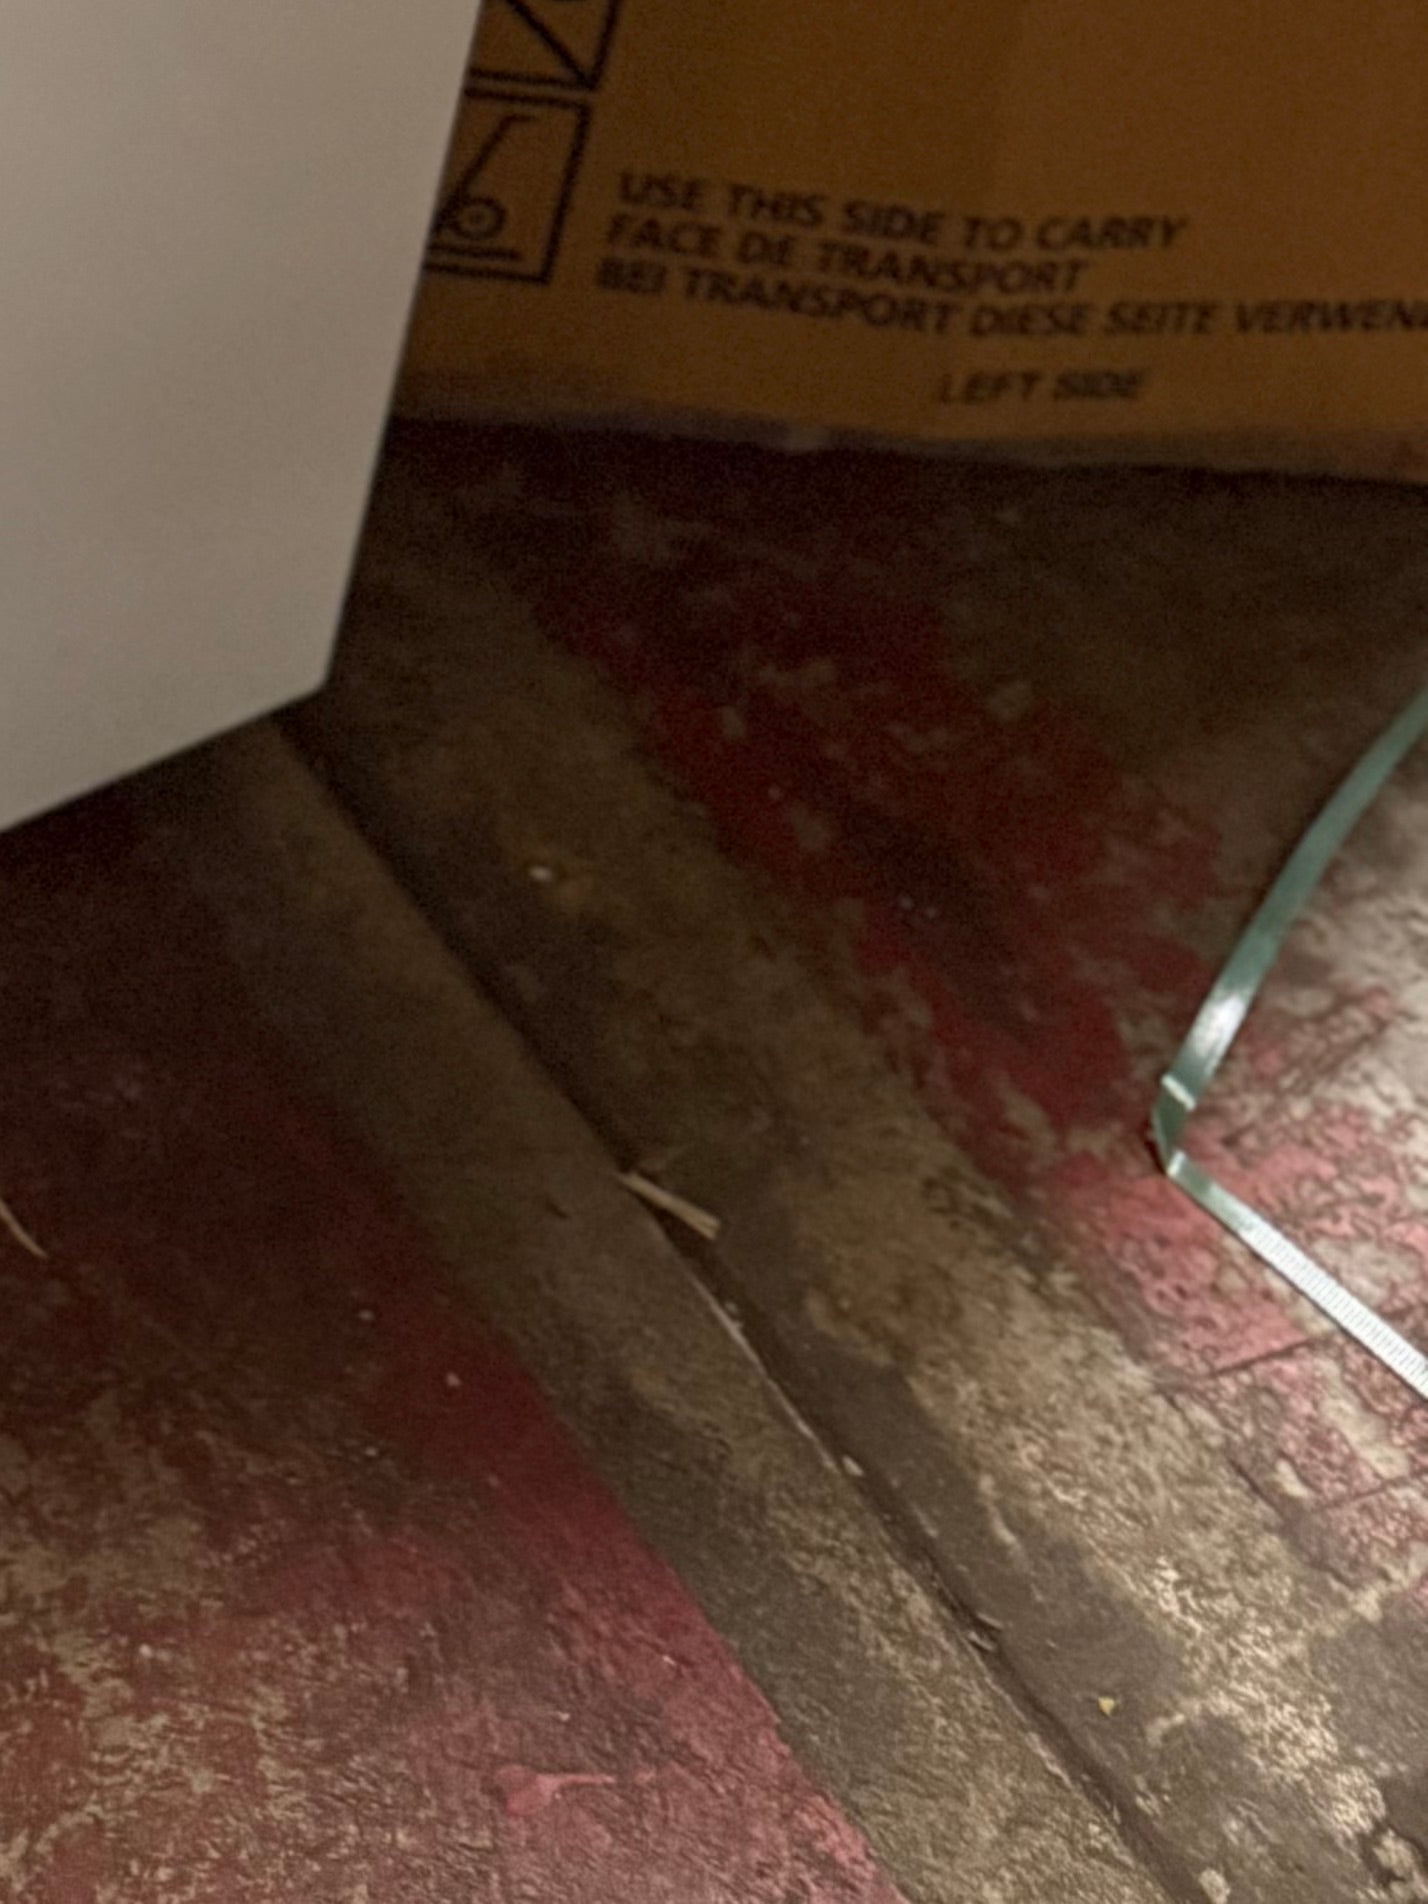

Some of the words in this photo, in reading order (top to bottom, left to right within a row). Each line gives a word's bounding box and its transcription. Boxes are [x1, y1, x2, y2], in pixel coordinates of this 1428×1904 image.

[617, 171, 702, 209] USE
[727, 182, 828, 228] THIS
[841, 200, 947, 247] SIDE
[963, 214, 1024, 252] TO
[1035, 213, 1190, 252] CARRY
[604, 212, 722, 258] FACE
[736, 230, 798, 267] DE
[815, 240, 1089, 296] TRANSPORT
[597, 257, 667, 294] BEI
[682, 265, 958, 335] TRANSPORT
[968, 300, 1094, 337] DIESE
[1101, 298, 1218, 335] SEITE
[1231, 298, 1428, 334] VERWEN
[940, 368, 1042, 404] LEFT
[1052, 369, 1144, 401] SIDE
